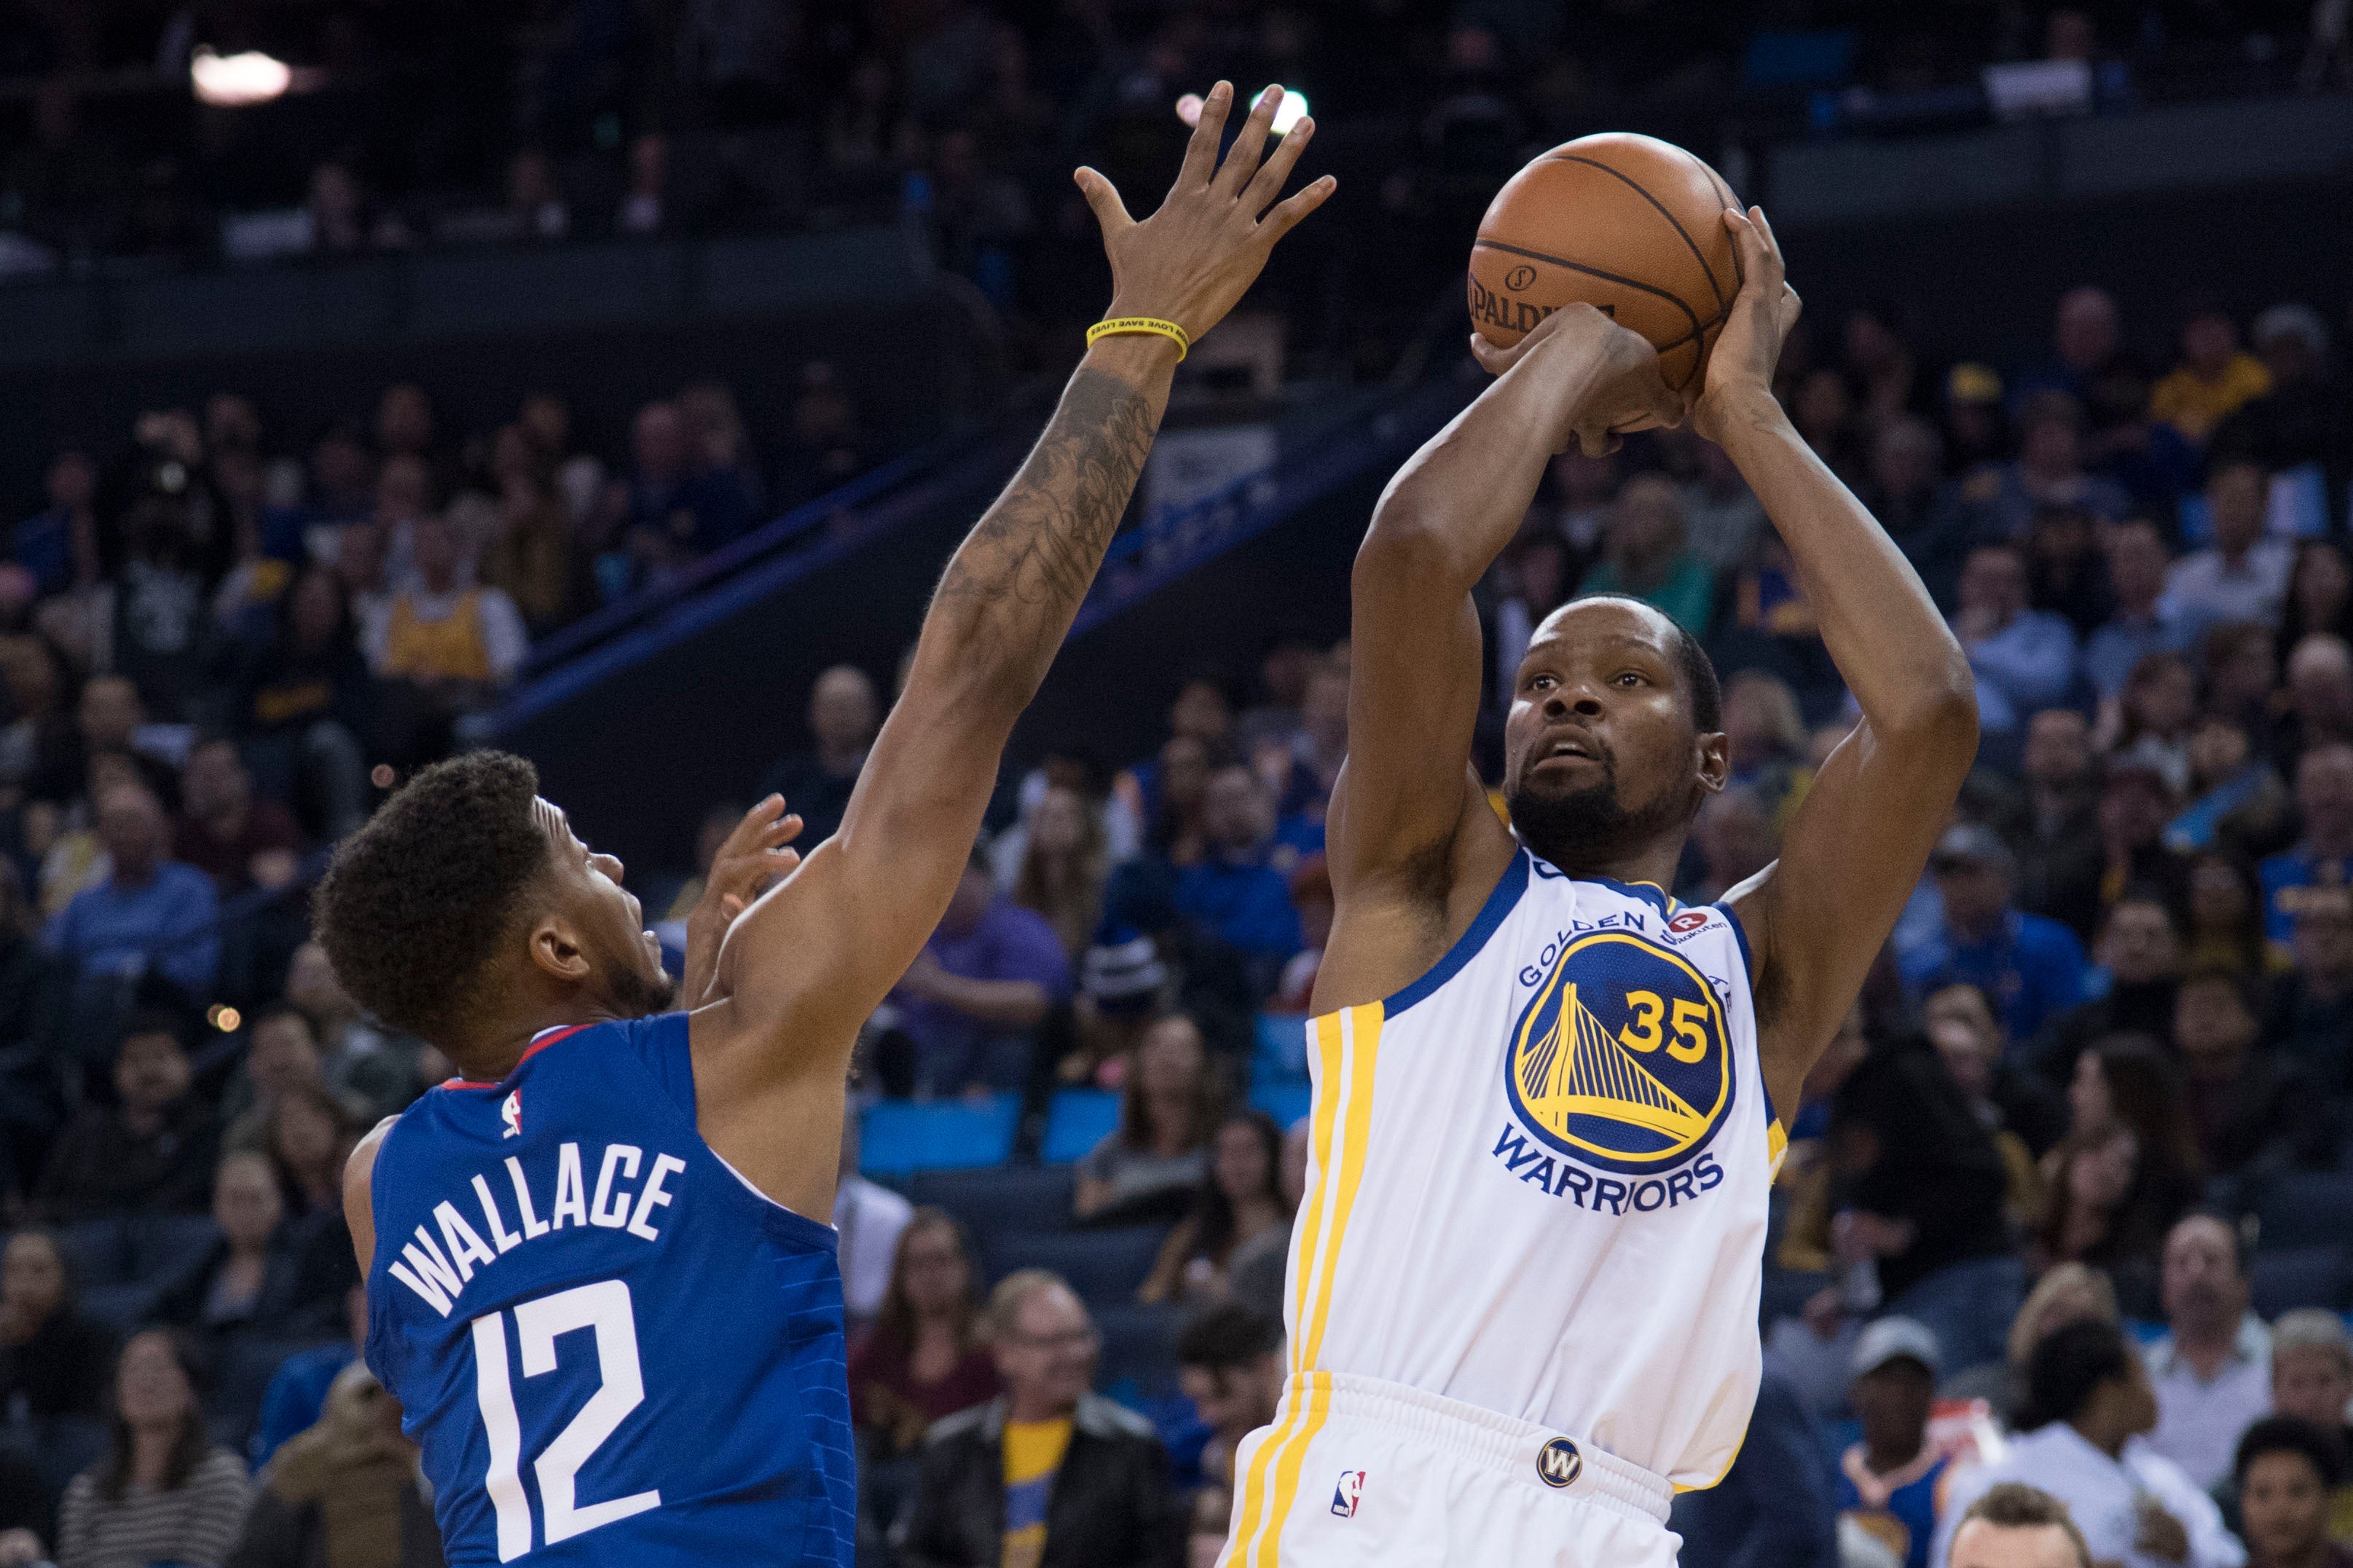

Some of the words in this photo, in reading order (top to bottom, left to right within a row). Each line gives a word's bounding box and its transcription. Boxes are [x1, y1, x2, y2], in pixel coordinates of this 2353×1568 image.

[1091, 323, 1115, 335] LIVES
[1148, 321, 1174, 333] LOVE
[1519, 911, 1645, 988] GOLDEN
[1678, 922, 1728, 945] Rakuten
[1618, 990, 1708, 1064] 35
[1492, 1122, 1724, 1216] WARRIORS
[388, 1142, 686, 1318] WALLACE
[471, 1279, 661, 1564] 12
[1544, 1446, 1580, 1481] W
